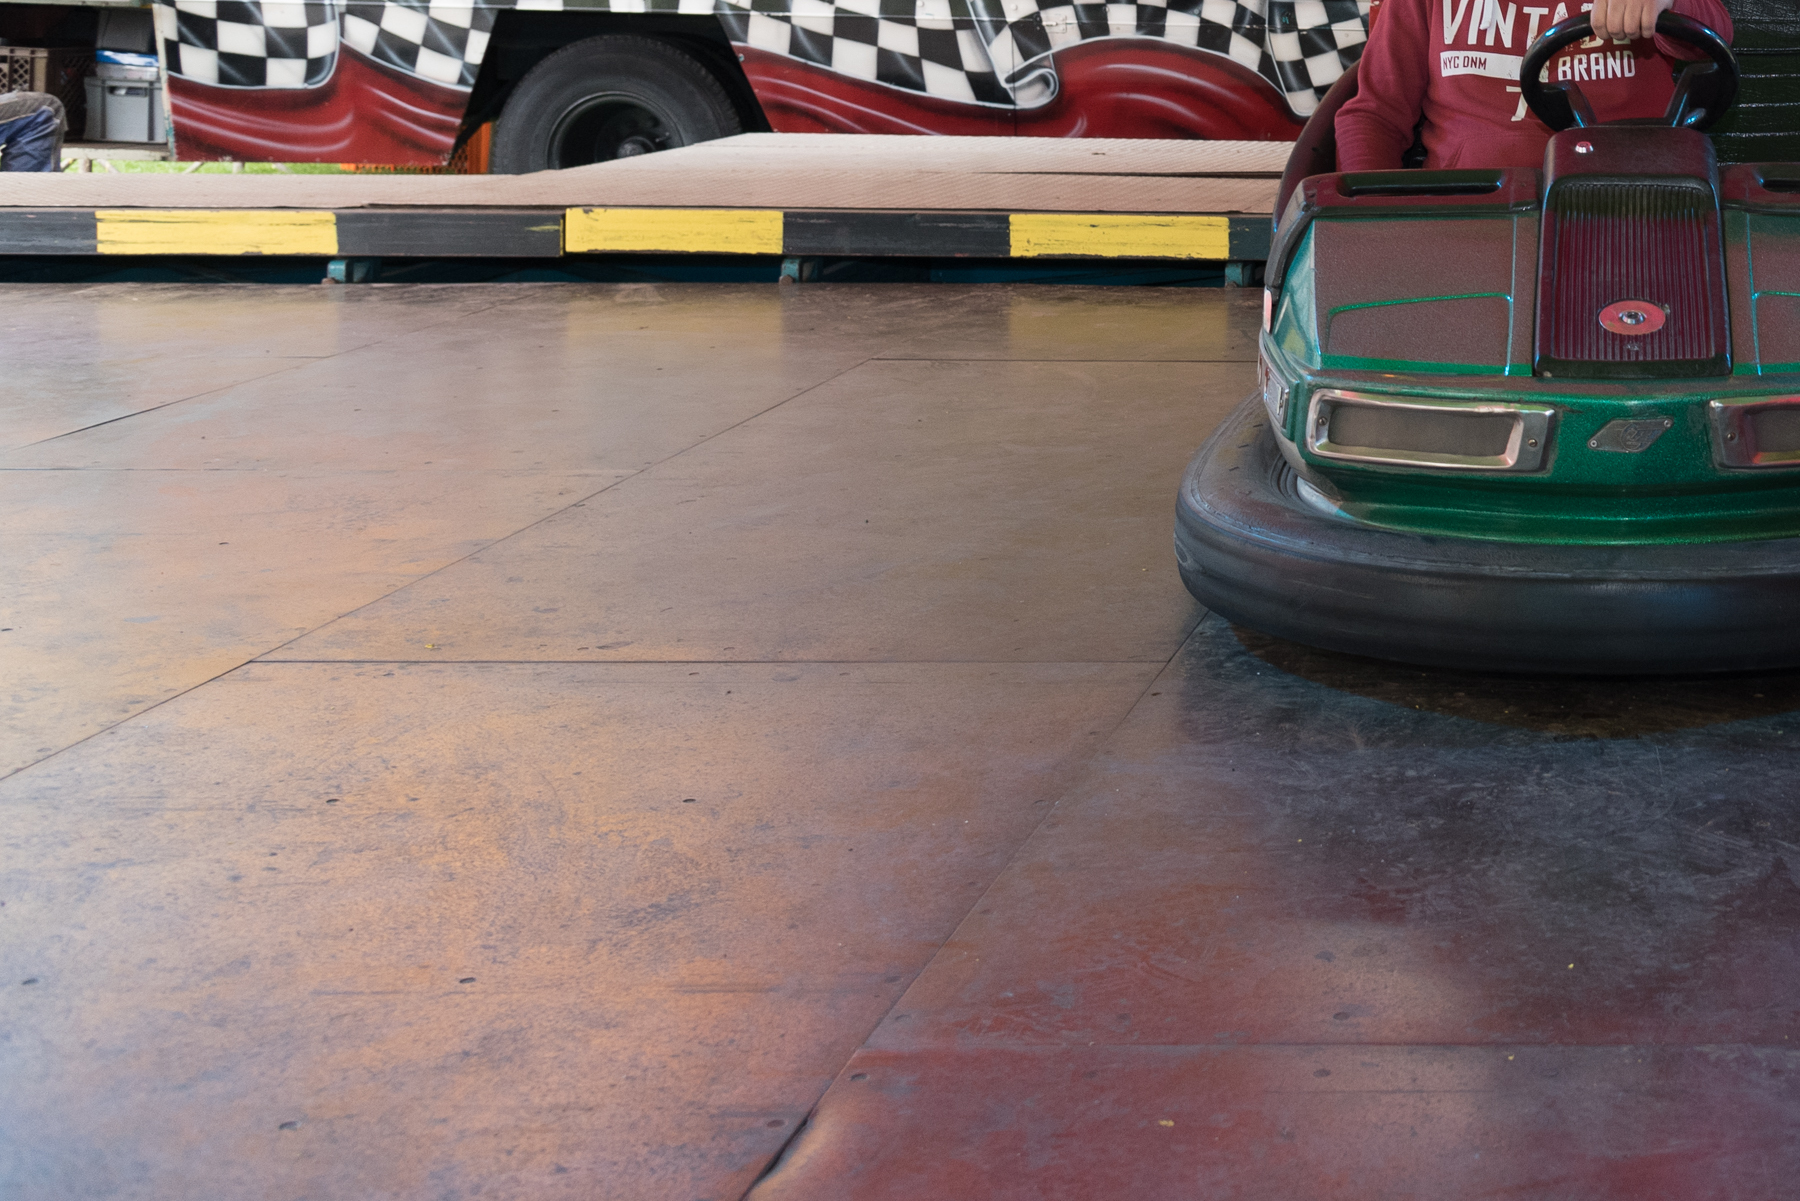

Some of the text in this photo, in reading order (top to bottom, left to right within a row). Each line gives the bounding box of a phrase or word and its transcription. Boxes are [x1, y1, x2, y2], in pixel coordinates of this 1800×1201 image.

[1443, 56, 1487, 71] NYC DNM
[1558, 50, 1636, 82] BRAND
